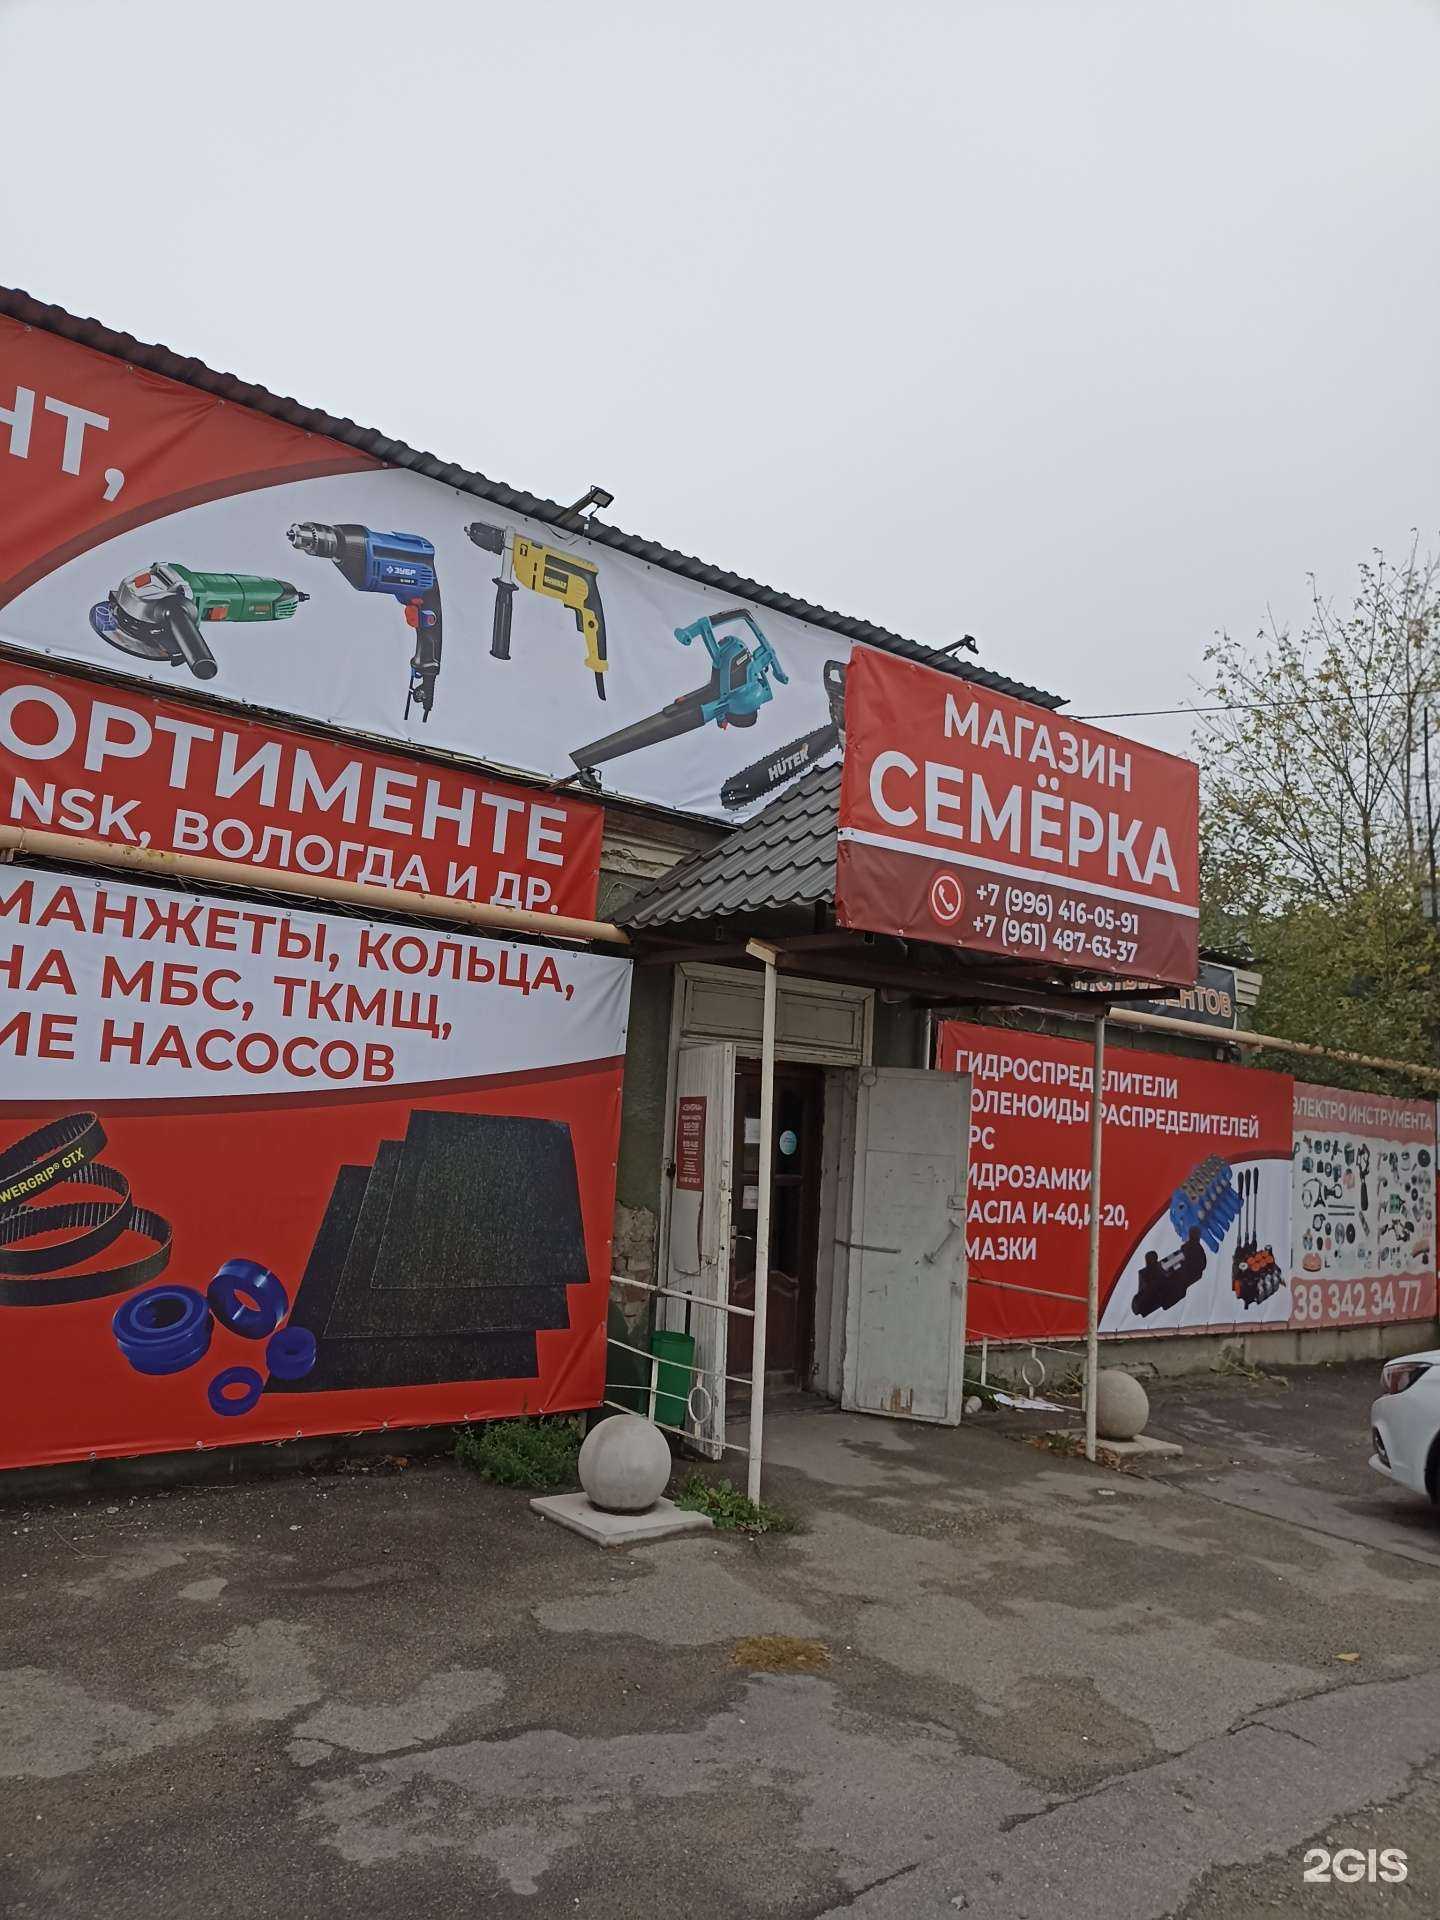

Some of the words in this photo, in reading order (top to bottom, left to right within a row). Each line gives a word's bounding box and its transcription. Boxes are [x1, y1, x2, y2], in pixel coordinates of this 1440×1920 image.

[944, 693, 1132, 793] МАГАЗИН
[0, 685, 568, 867] ОРТИМЕНТЕ
[10, 776, 151, 848] NSK,
[172, 808, 431, 893] ВОЛОГДА
[446, 861, 478, 900] И
[490, 871, 559, 914] ДР.
[869, 750, 1181, 893] СЕМЁРКА
[976, 883, 1000, 906] +7
[1005, 886, 1053, 922] (996)
[1058, 899, 1139, 935] 416-05-91
[0, 880, 340, 973] МАНЖЕТЫ,
[358, 930, 576, 1001] КОЛЬЦА,
[973, 914, 997, 938] +7
[1002, 917, 1047, 952] (961)
[1053, 927, 1138, 963] 487-63-37
[101, 956, 254, 1021] МБС,
[273, 975, 452, 1040] ТКМЩ,
[100, 1018, 396, 1083] НАСОСОВ
[971, 1088, 1090, 1125] ОЛЕНОИДЫ
[1349, 1103, 1433, 1131] ИНСТРУМЕНТА
[61, 1147, 85, 1168] GTX
[969, 1125, 995, 1150] РС
[968, 1163, 1092, 1191] ИДРОЗАМКИ
[967, 1200, 1027, 1224] АСЛА
[965, 1236, 1037, 1261] МАЗКИ
[1328, 1283, 1367, 1318] 342
[1370, 1281, 1396, 1315] 34
[1399, 1280, 1421, 1313] 77
